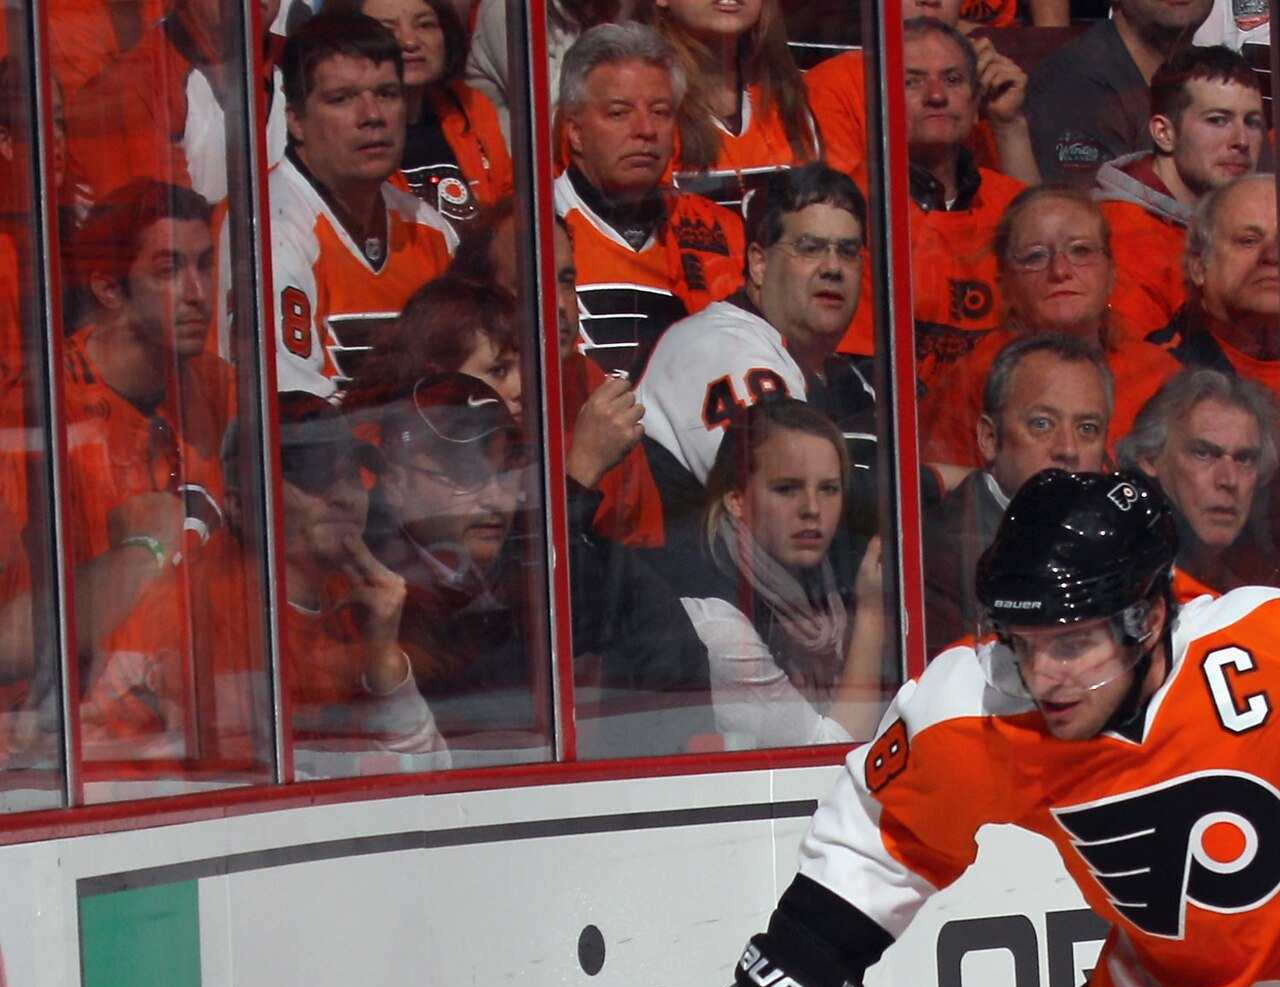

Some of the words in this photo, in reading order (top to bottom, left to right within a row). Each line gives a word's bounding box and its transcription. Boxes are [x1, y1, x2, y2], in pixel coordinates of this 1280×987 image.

[281, 285, 312, 360] 8
[994, 599, 1042, 609] BAUER
[1200, 643, 1272, 736] C
[865, 716, 910, 794] 8
